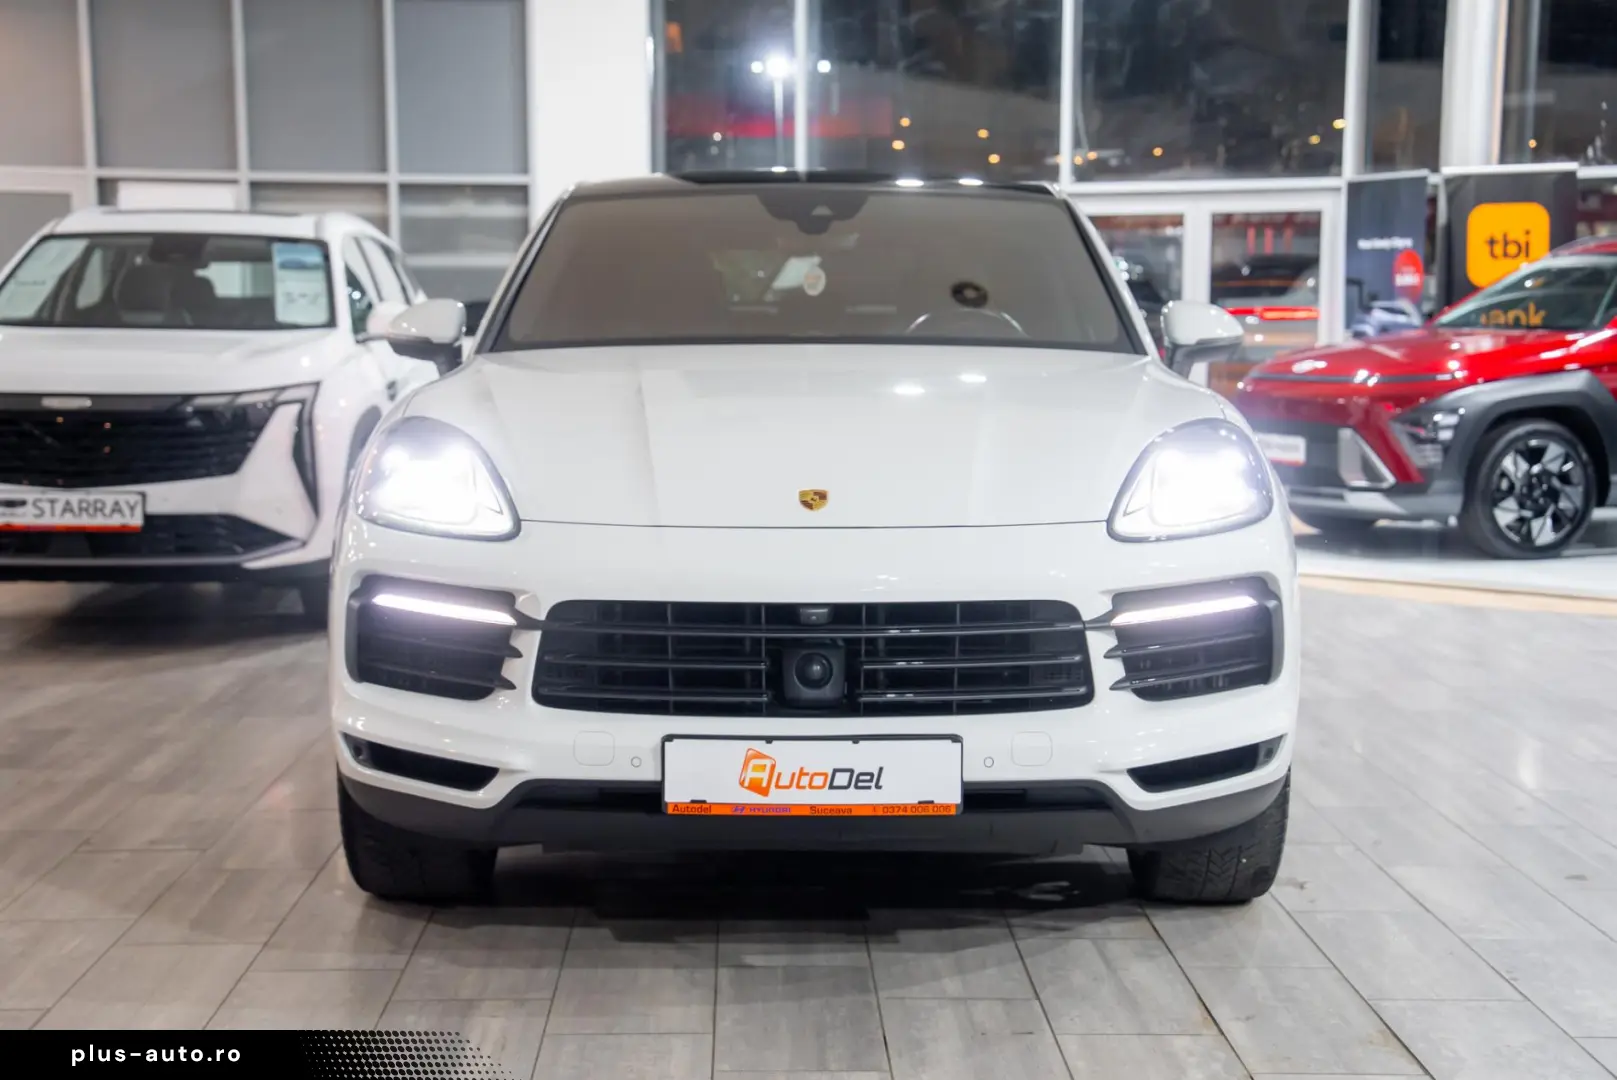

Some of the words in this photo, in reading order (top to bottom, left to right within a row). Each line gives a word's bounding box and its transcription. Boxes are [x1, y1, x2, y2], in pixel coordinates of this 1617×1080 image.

[1484, 229, 1530, 259] tbi
[31, 498, 140, 519] STARRAY
[741, 753, 884, 792] AutoDel
[672, 804, 712, 814] Autodel
[749, 806, 791, 814] HYUNDAI
[809, 805, 853, 815] Suceava
[882, 805, 908, 814] 0374
